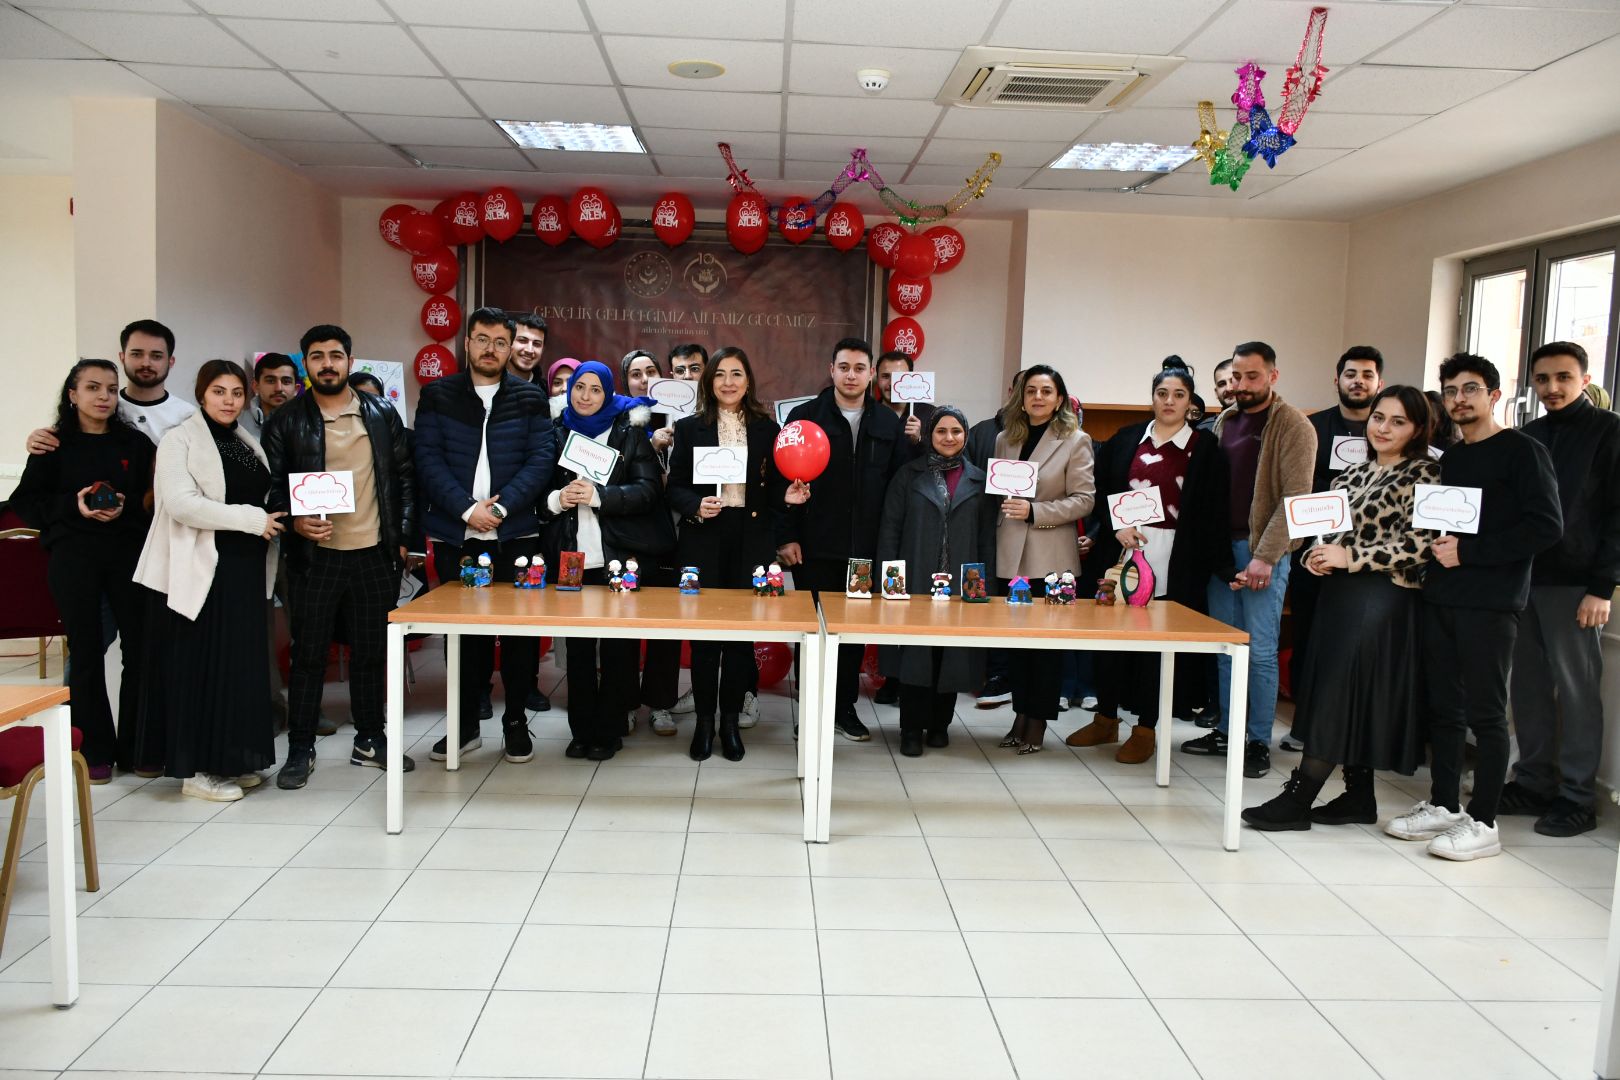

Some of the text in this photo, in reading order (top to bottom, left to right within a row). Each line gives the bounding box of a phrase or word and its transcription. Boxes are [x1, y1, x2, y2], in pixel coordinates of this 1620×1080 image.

[534, 305, 816, 328] GENÇLİK GELECEĞİMİZ AİLEMİZ GÜCÜMÜZ
